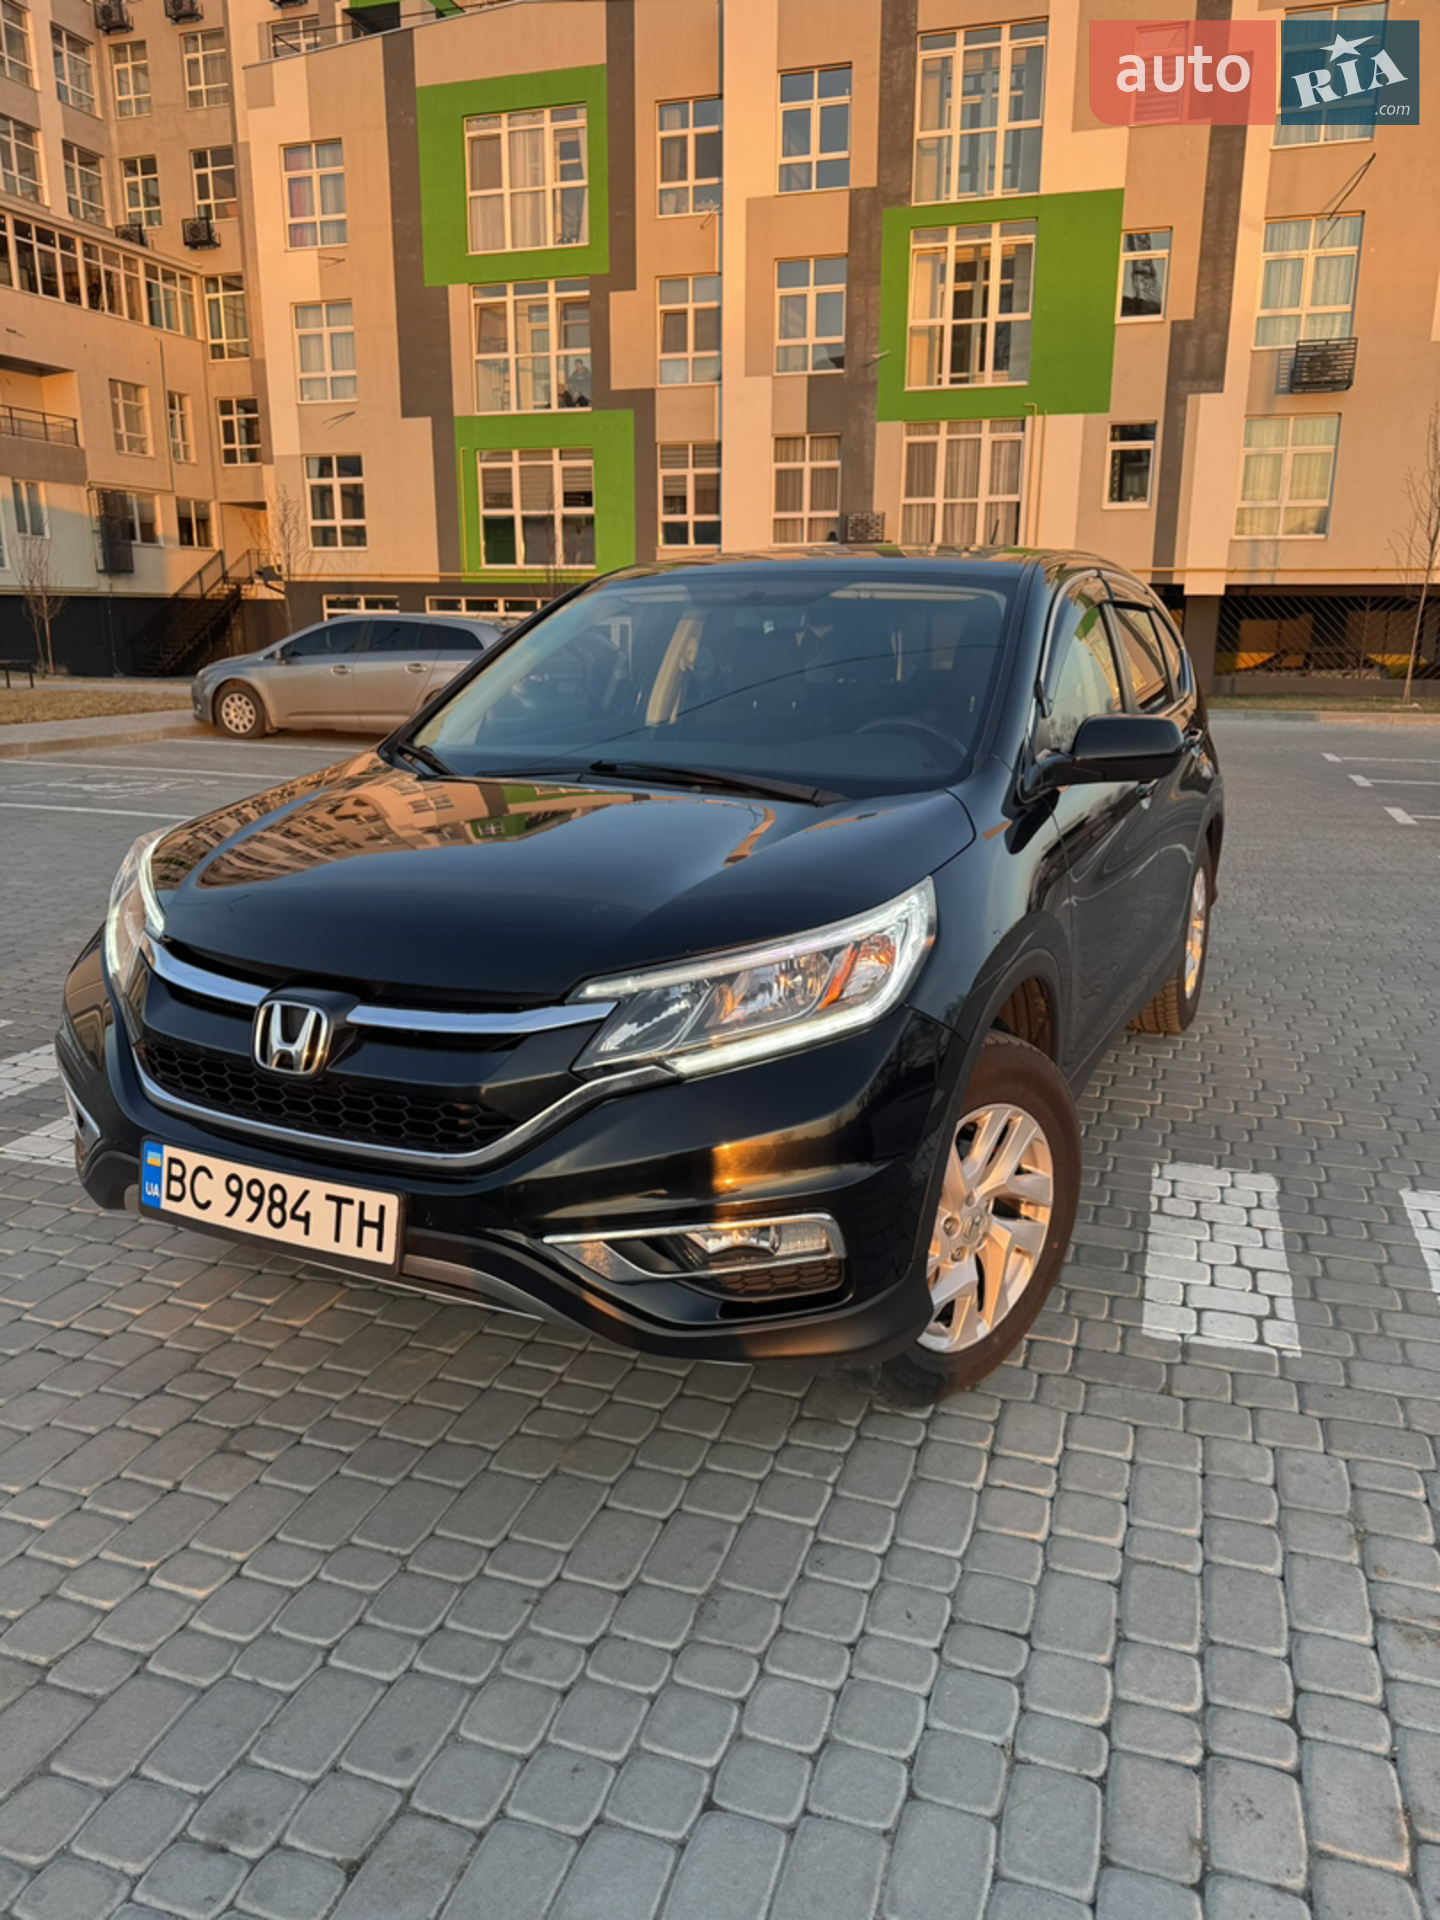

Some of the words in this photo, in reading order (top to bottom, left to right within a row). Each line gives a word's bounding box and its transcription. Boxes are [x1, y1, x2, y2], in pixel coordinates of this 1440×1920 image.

[145, 1181, 160, 1198] UA
[166, 1156, 214, 1211] BC
[224, 1173, 312, 1237] 9984
[325, 1193, 386, 1252] TH
